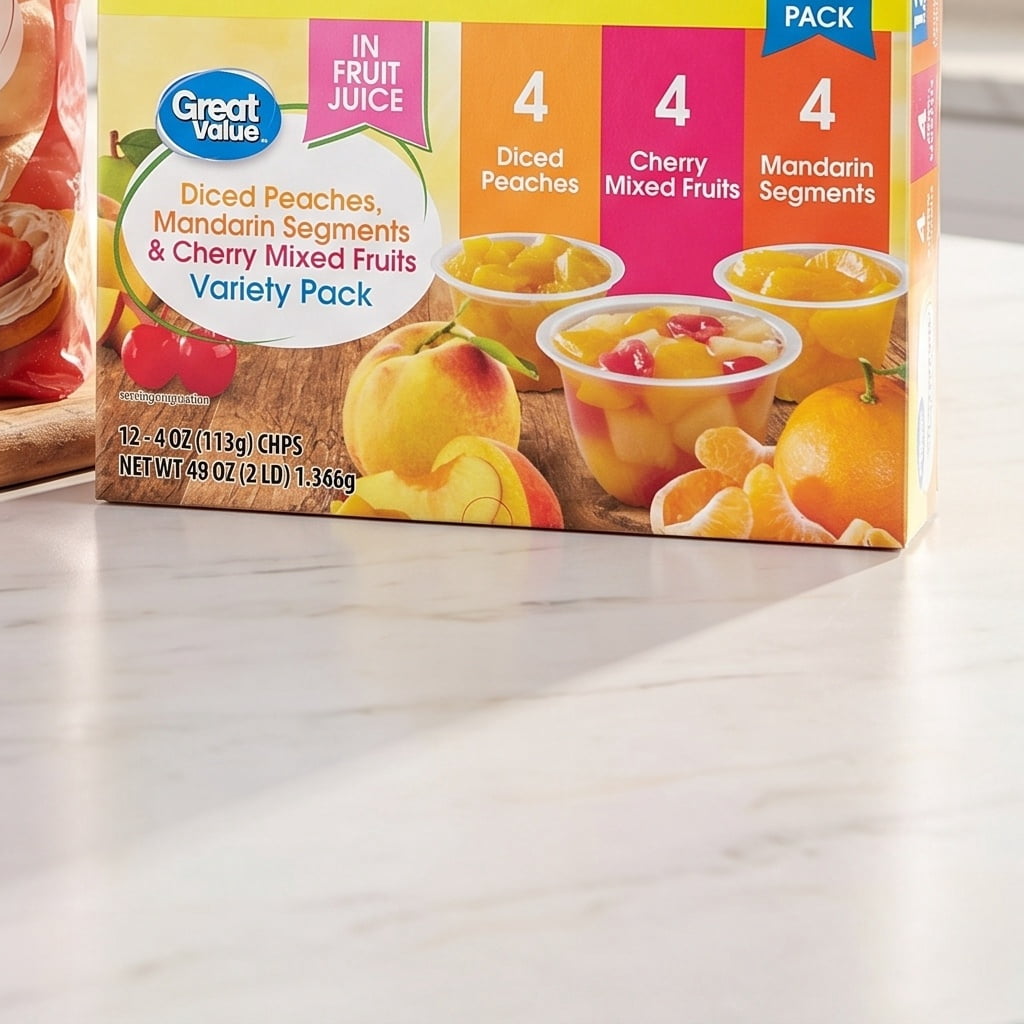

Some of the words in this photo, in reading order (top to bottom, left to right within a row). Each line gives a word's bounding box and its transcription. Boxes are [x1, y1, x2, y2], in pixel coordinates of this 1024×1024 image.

[784, 6, 855, 29] PACK
[352, 34, 380, 58] IN
[333, 60, 401, 86] FRUIT
[171, 89, 260, 123] Great
[327, 87, 404, 113] JUICE
[513, 70, 549, 123] 4
[655, 74, 691, 127] 4
[799, 77, 836, 131] 4
[191, 120, 261, 144] Value
[496, 146, 565, 169] Diced
[629, 150, 709, 179] Cherry
[760, 154, 875, 179] Mandarin
[481, 172, 580, 196] Peaches
[604, 175, 676, 198] Mixed
[682, 177, 741, 200] Fruits
[758, 179, 877, 207] Segments
[181, 182, 256, 208] Diced
[264, 185, 383, 216] Peaches,
[153, 210, 275, 238] Mandarin
[282, 215, 411, 246] Segments
[147, 238, 166, 263] &
[172, 241, 257, 271] Cherry
[265, 244, 345, 270] Mixed
[353, 248, 417, 273] Fruits
[189, 273, 292, 309] Variety
[301, 278, 373, 307] Pack
[118, 426, 140, 447] 12
[154, 429, 165, 448] 4
[168, 429, 192, 450] OZ
[195, 429, 253, 457] (113g)
[119, 455, 152, 477] NET
[155, 457, 183, 480] WT
[212, 462, 236, 483] OZ
[239, 462, 257, 486] (2
[295, 466, 357, 494] 1.366g
